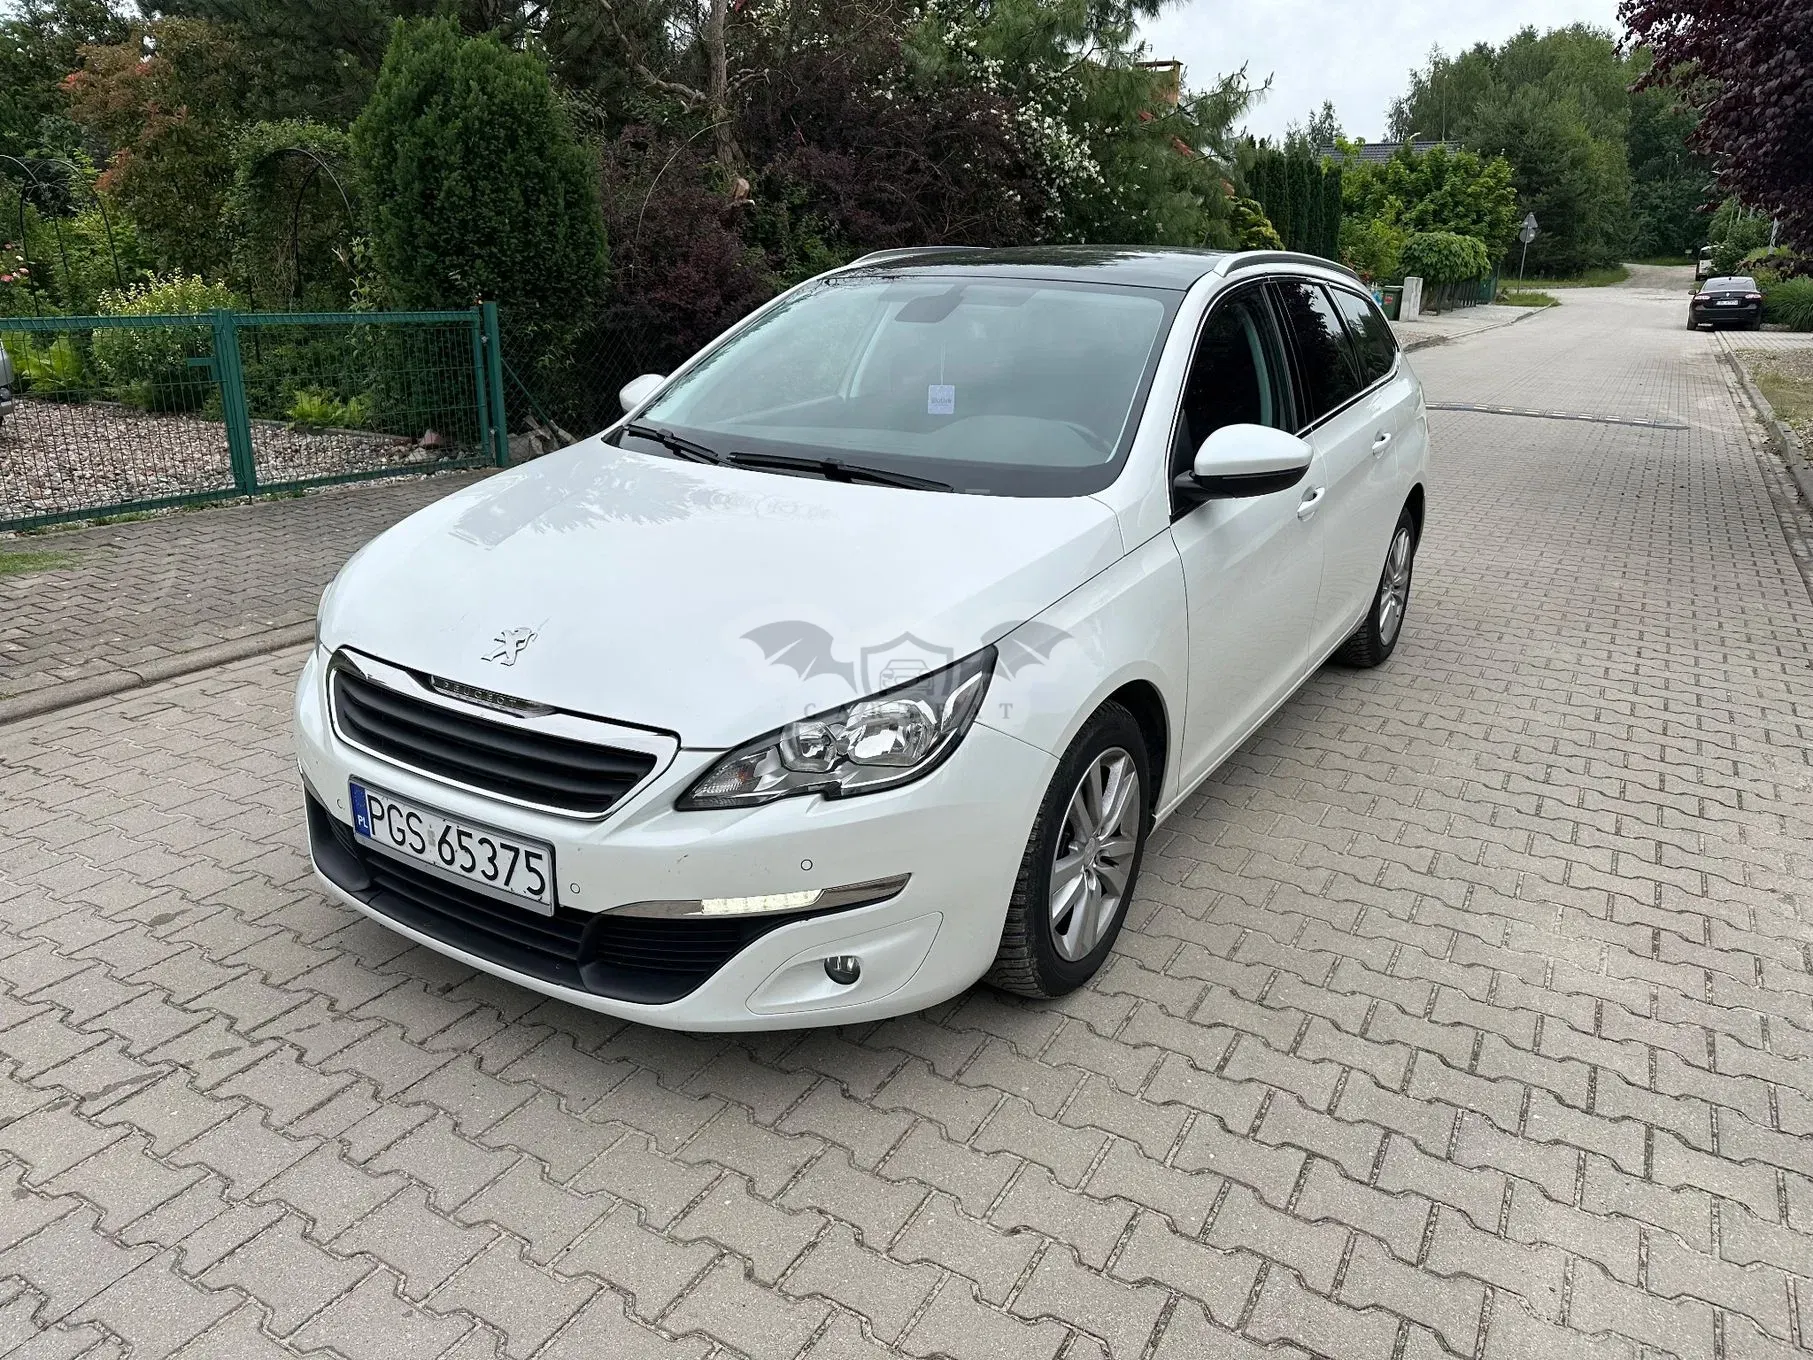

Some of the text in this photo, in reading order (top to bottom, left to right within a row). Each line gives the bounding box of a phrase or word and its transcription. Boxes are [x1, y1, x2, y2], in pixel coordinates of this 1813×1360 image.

[357, 814, 369, 829] PL
[367, 794, 546, 896] PGS 65375
